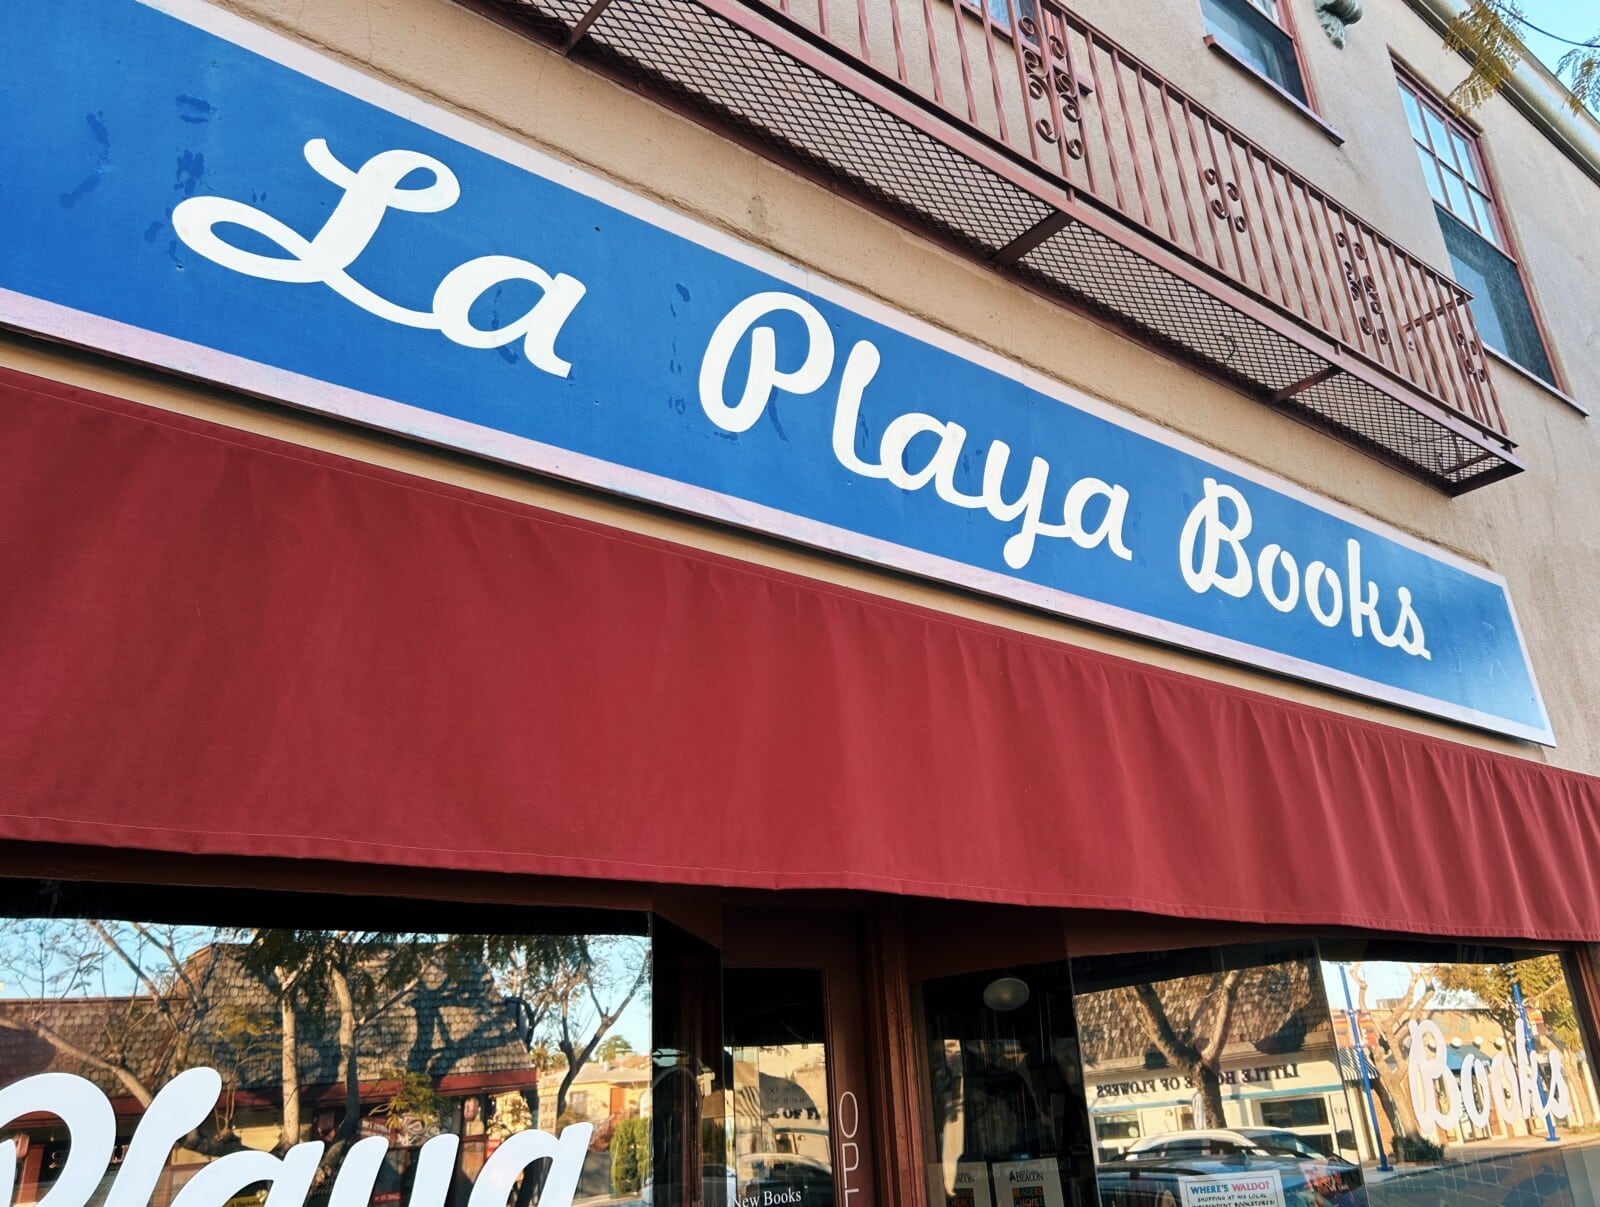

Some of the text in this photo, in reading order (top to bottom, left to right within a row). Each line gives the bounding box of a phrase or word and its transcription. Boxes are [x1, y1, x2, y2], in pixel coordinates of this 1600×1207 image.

[172, 138, 1432, 661] La Playa Books
[1408, 1018, 1574, 1135] Books
[732, 1195, 760, 1207] New
[764, 1188, 802, 1206] Books
[1190, 1181, 1270, 1195] WHERE'S WALDO?
